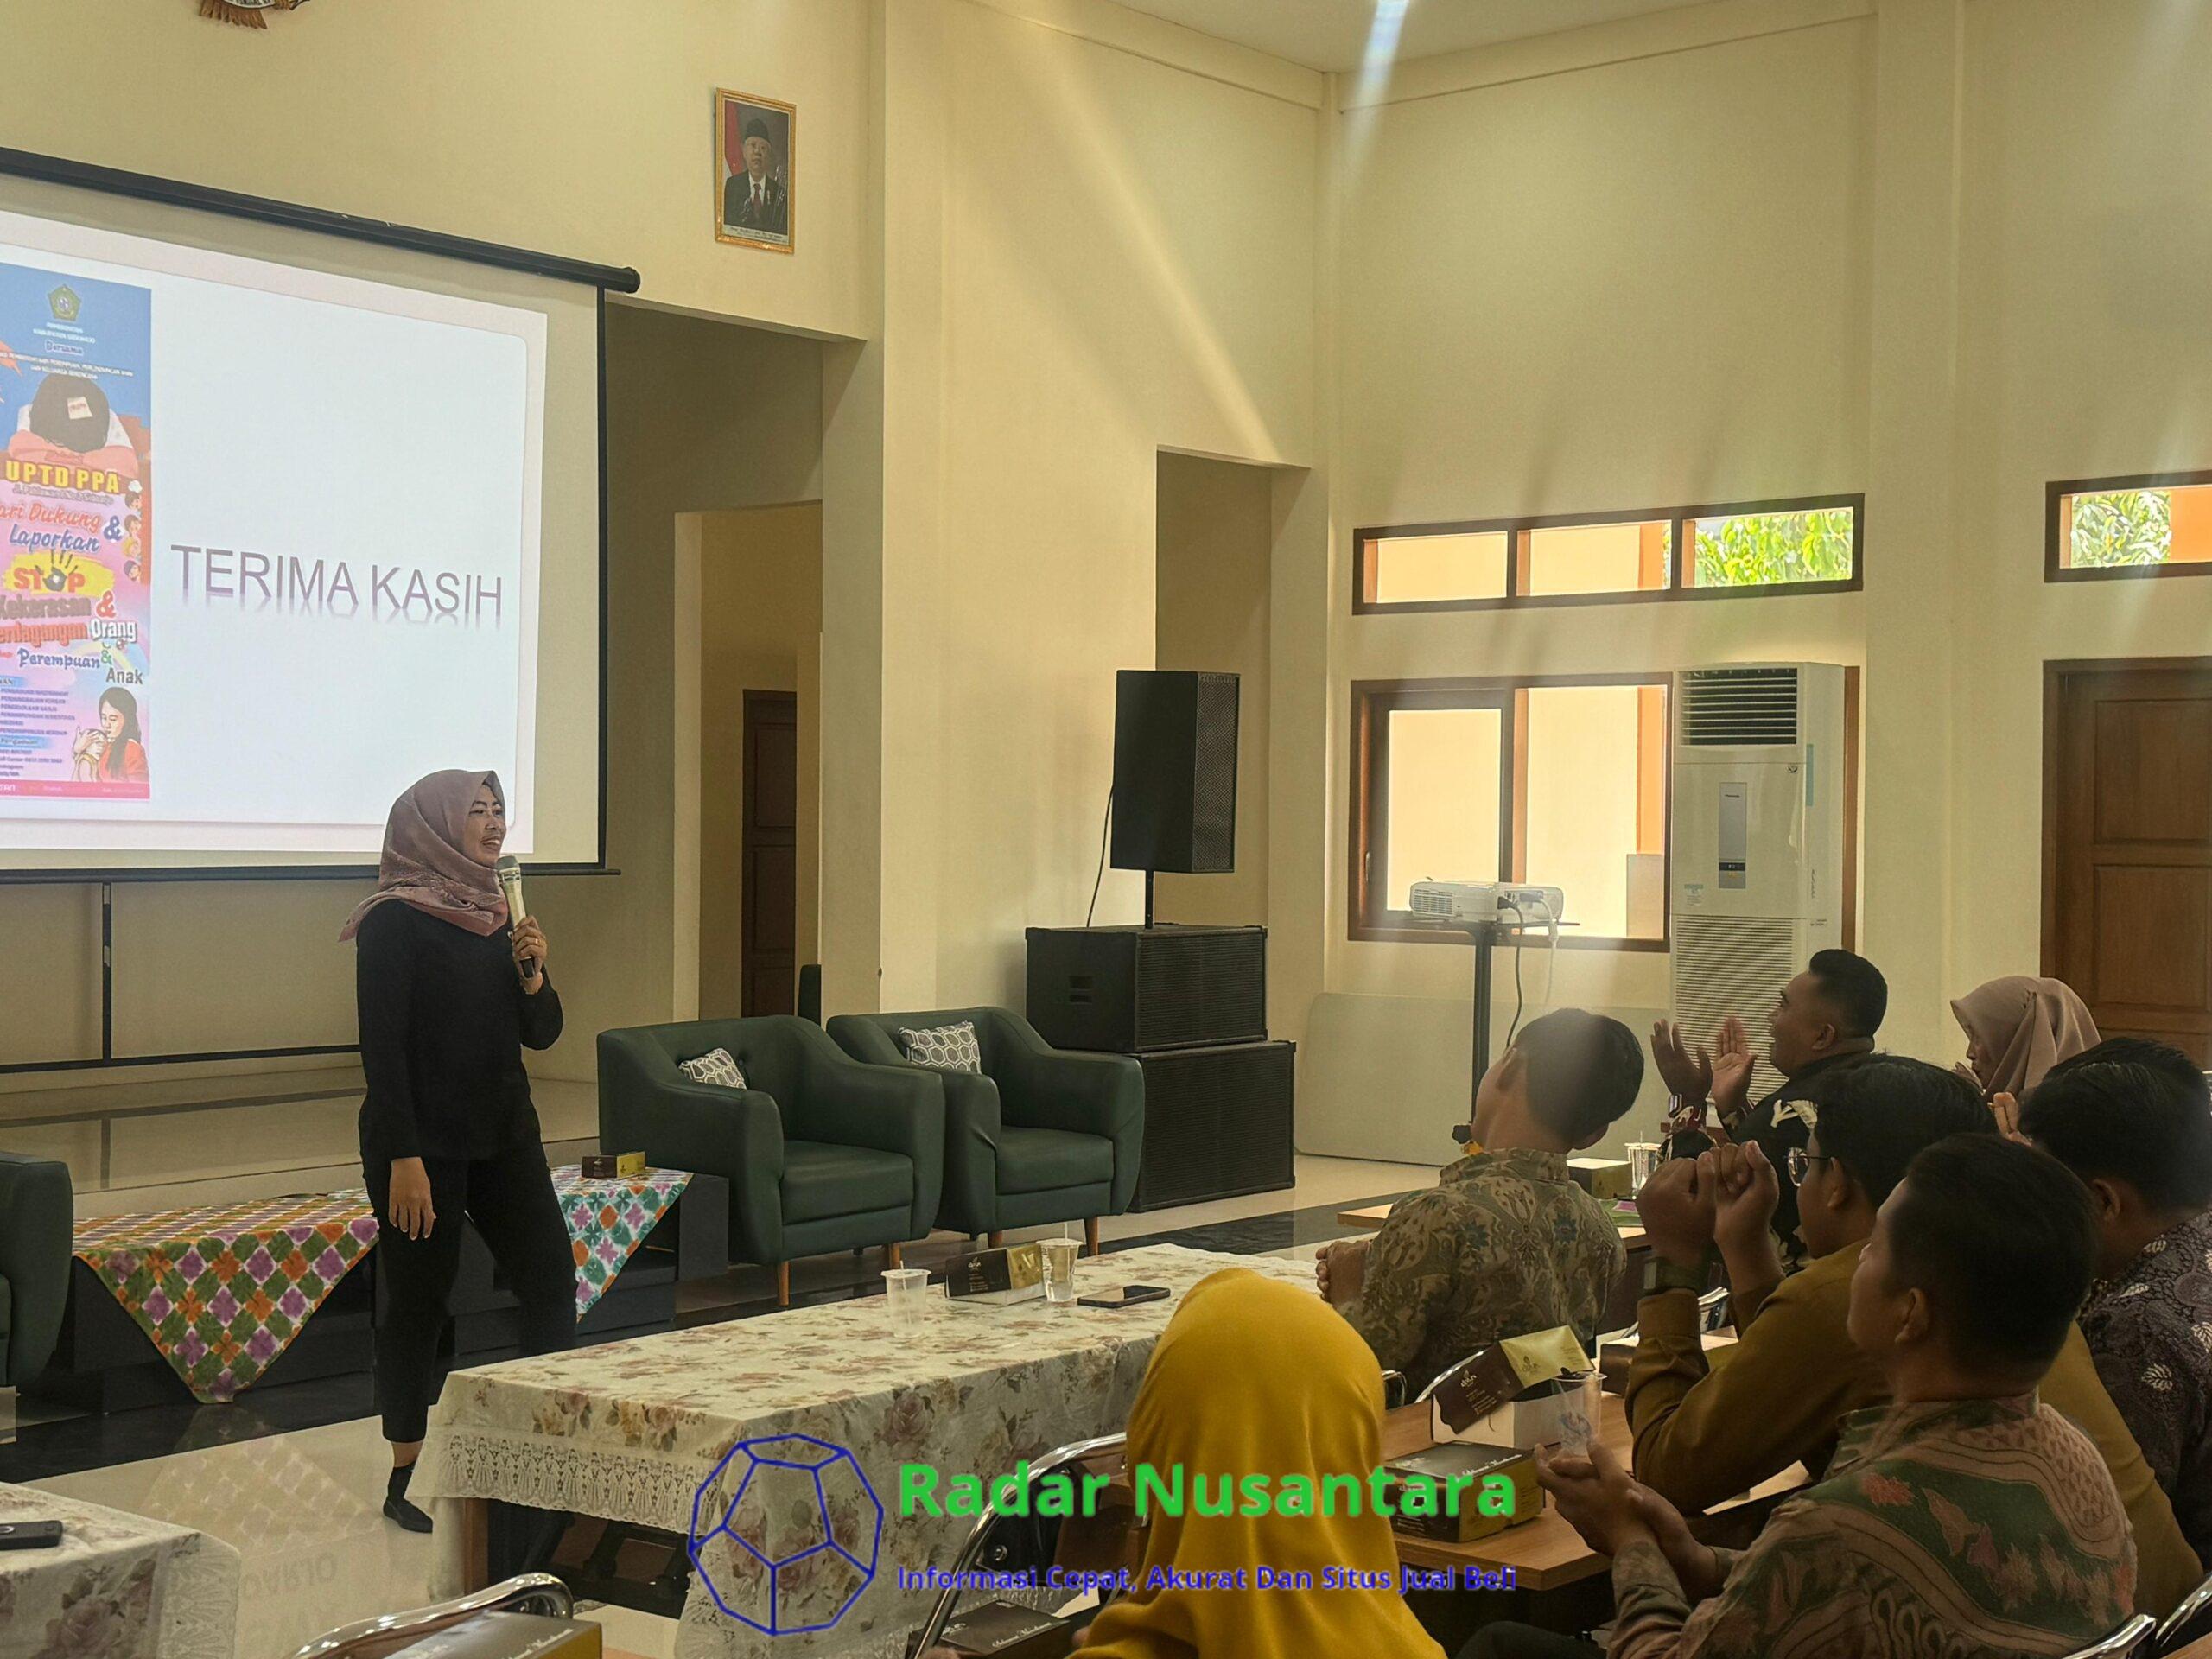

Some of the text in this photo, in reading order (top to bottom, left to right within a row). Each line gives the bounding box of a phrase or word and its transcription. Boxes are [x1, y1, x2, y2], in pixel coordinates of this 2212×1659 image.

[6, 460, 119, 493] UPTD PPA
[29, 503, 101, 532] Dukung
[10, 524, 99, 551] Laporkan
[171, 544, 501, 614] TERIMA KASIH
[91, 620, 137, 641] Orang
[17, 648, 100, 669] Perempuan
[106, 667, 143, 684] Anak
